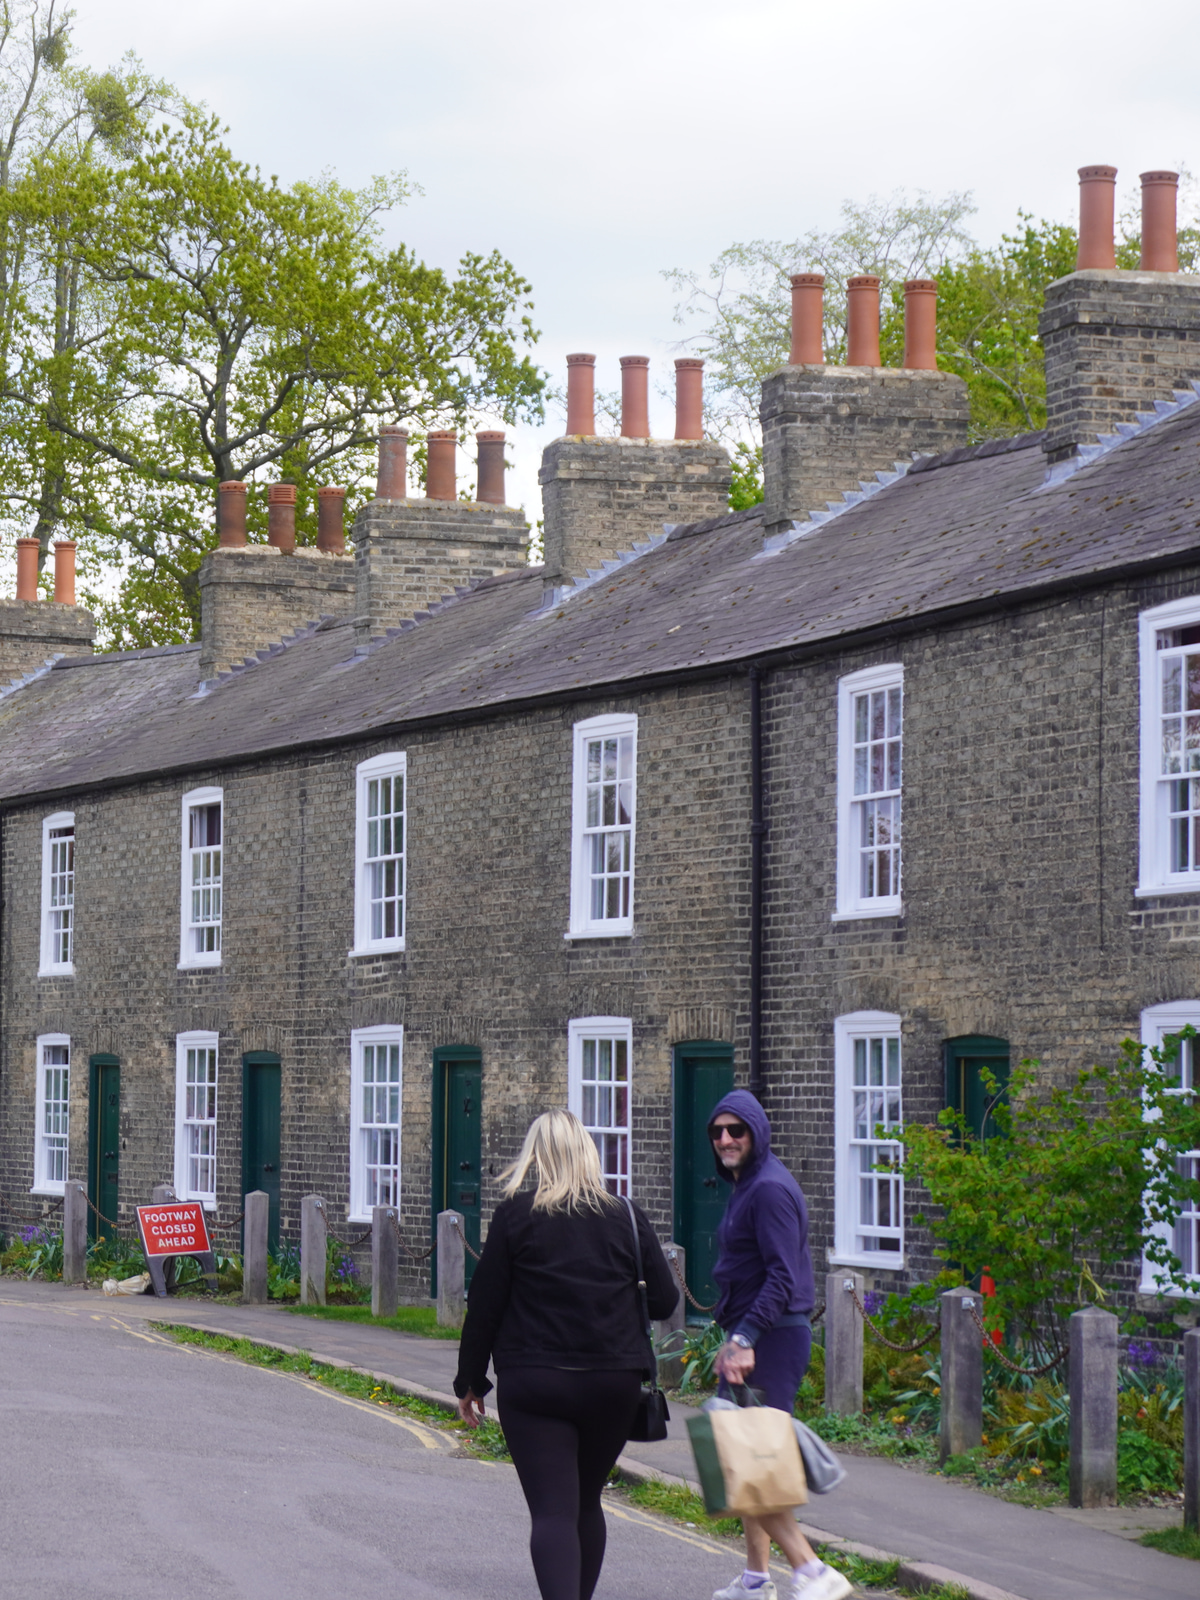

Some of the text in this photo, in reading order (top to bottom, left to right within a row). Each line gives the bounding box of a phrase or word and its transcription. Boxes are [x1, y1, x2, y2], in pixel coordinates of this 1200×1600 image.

[144, 1210, 197, 1223] FOOTWAY
[151, 1223, 196, 1235] CLOSED
[158, 1236, 195, 1248] AHEAD
